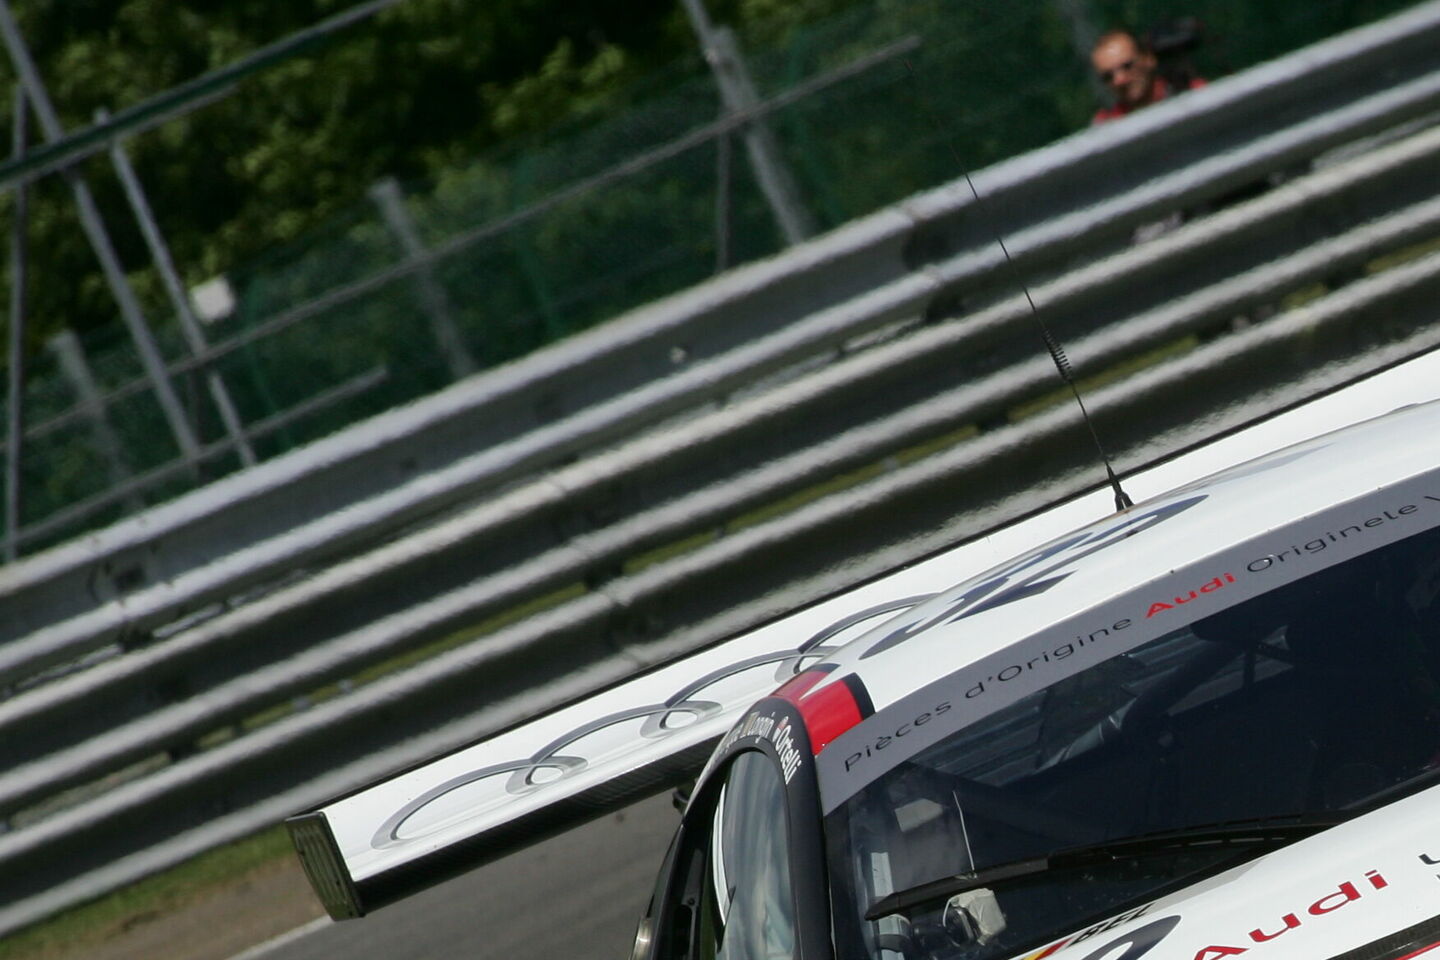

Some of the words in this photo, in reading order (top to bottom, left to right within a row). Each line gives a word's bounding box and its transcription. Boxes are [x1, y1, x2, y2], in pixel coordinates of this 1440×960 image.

[845, 701, 951, 772] Pièces
[1146, 573, 1236, 618] Audi
[1247, 503, 1418, 573] Originele
[775, 724, 802, 785] Ortelli
